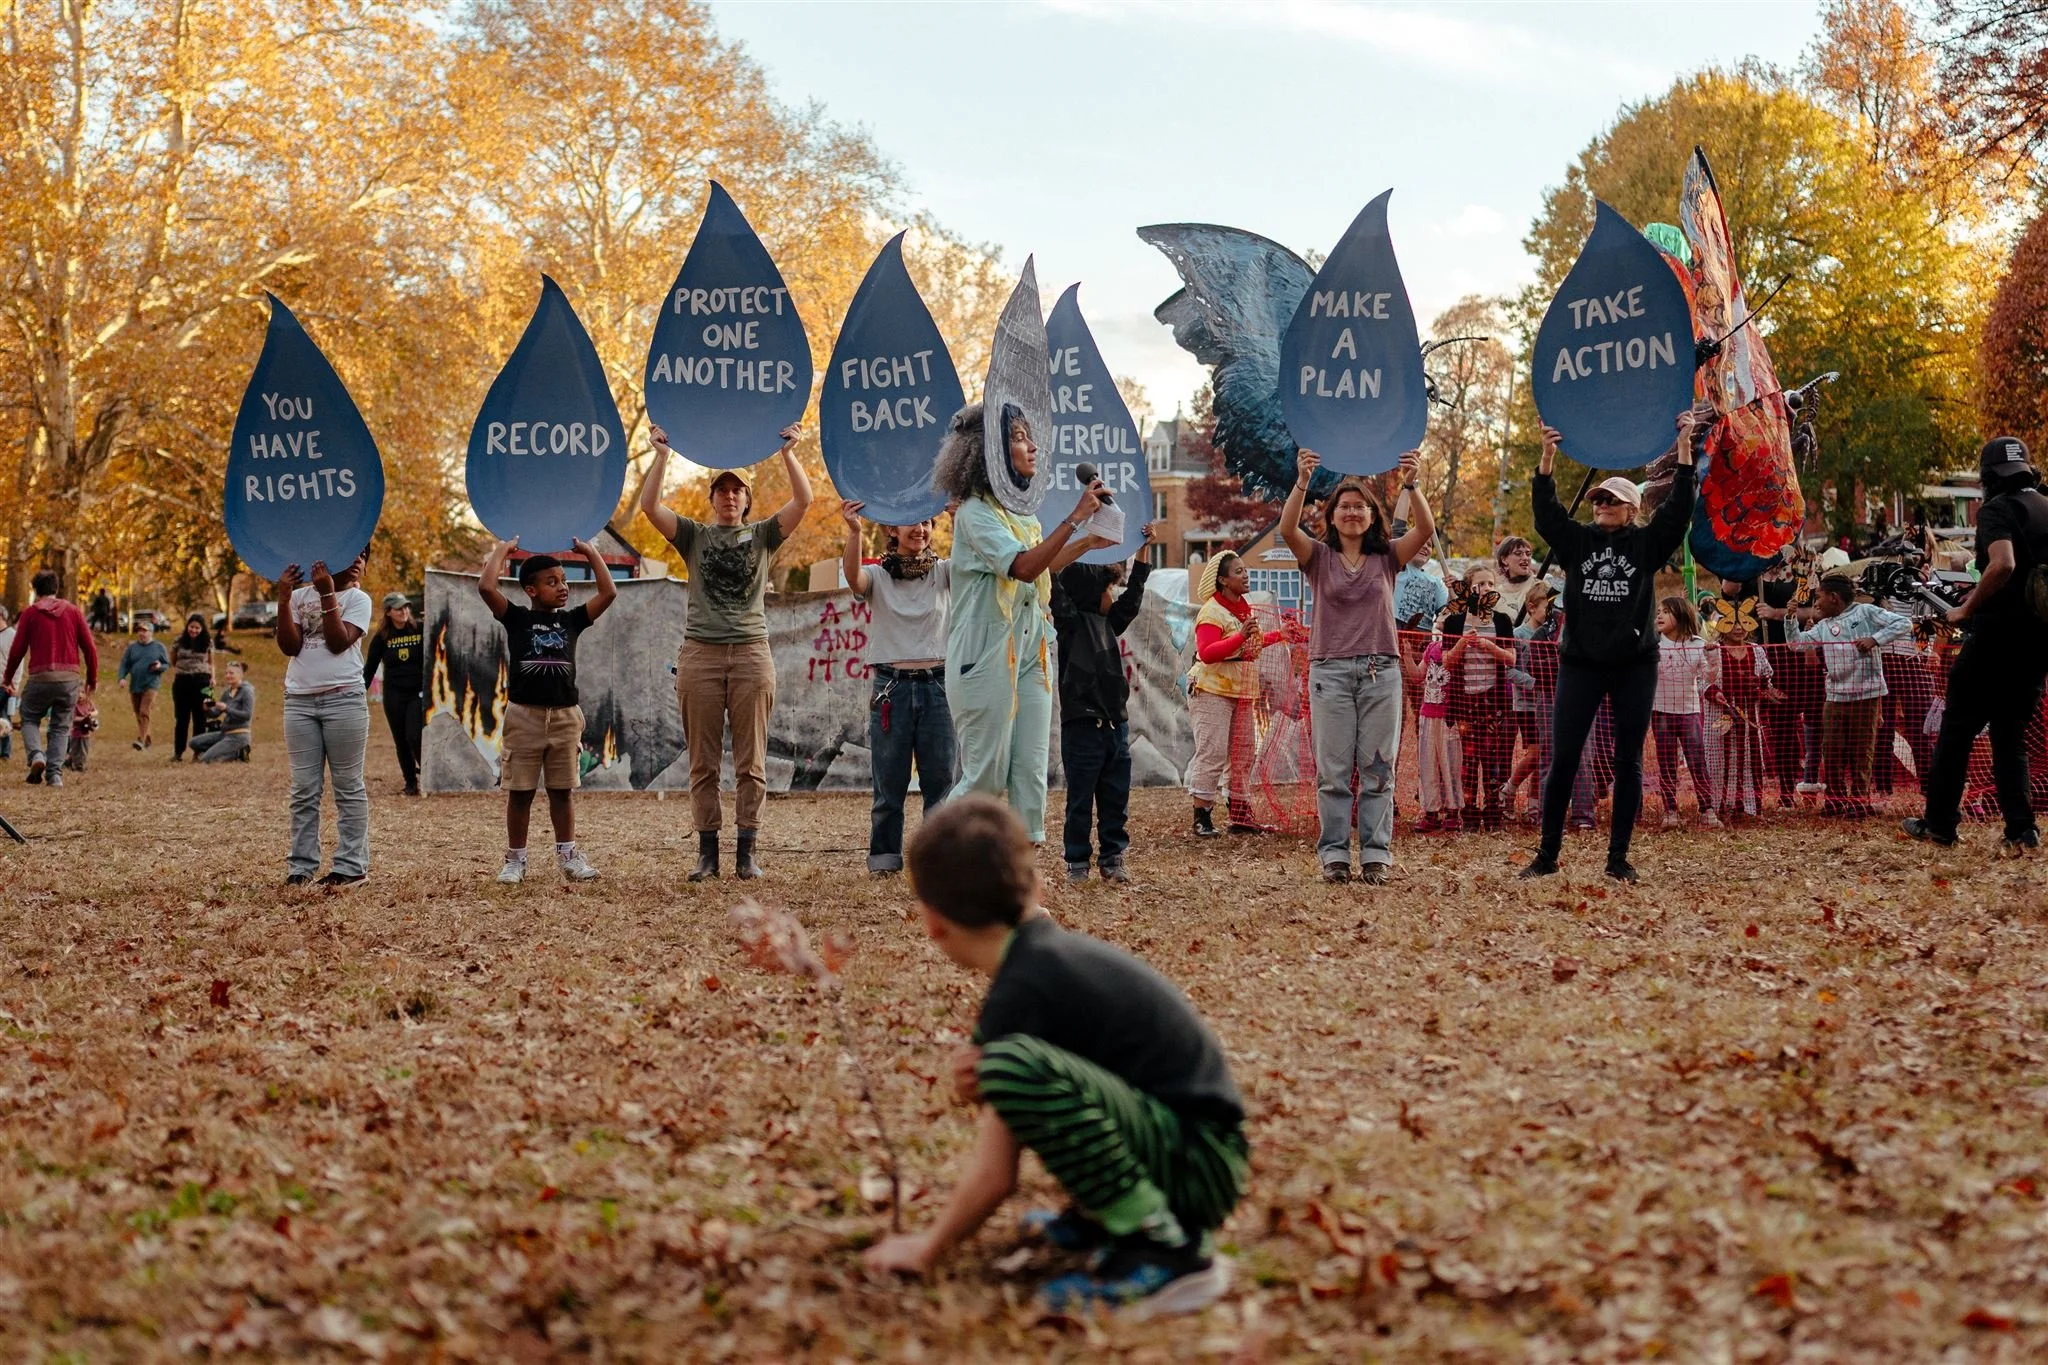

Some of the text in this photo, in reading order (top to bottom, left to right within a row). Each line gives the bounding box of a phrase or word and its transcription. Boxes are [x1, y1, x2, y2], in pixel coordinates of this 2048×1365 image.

[674, 286, 787, 316] PROTECT
[1310, 290, 1392, 320] MAKE
[1568, 284, 1645, 330] TAKE
[702, 320, 759, 351] ONE
[1331, 327, 1357, 360] A
[651, 353, 797, 394] ANOTHER
[841, 349, 934, 390] FIGHT
[1552, 332, 1676, 384] ACTION
[1300, 365, 1382, 399] PLAN
[261, 392, 313, 421] YOU
[851, 395, 937, 433] BACK
[250, 430, 323, 459] HAVE
[486, 421, 610, 457] RECORD
[245, 468, 357, 503] RIGHTS
[1582, 579, 1630, 595] EAGLES
[820, 601, 844, 625] A
[813, 628, 868, 653] AND
[808, 657, 838, 683] IT
